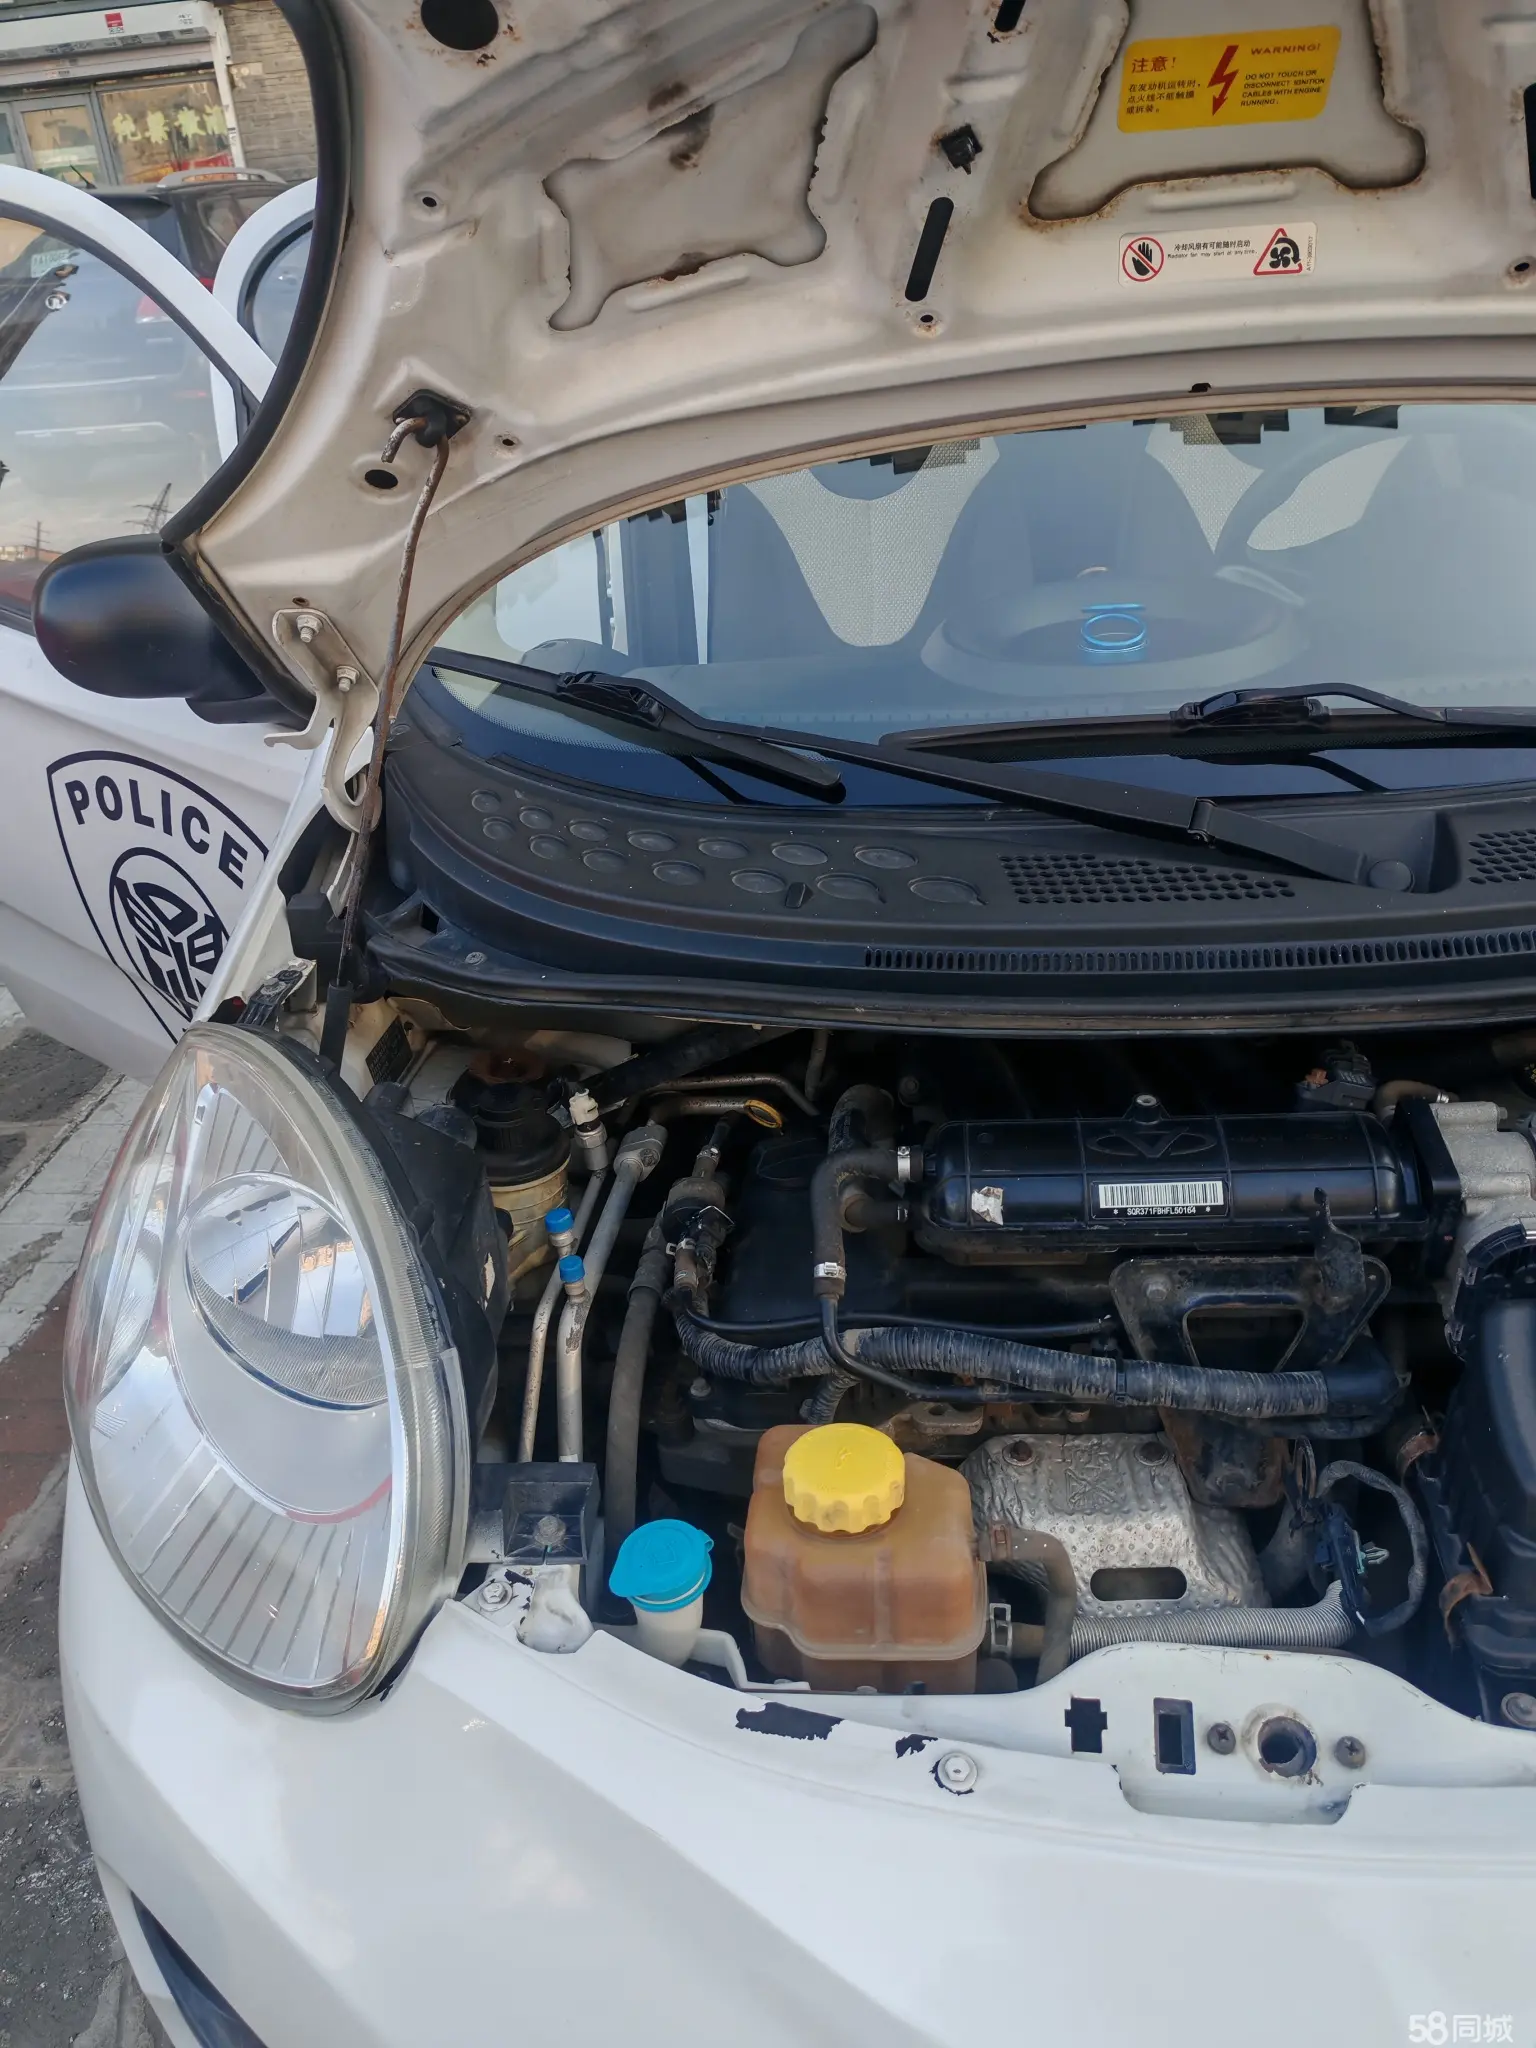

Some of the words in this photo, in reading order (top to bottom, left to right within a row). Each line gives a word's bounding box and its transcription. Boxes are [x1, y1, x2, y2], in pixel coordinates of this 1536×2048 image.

[1251, 43, 1321, 56] WARNING!
[1278, 70, 1304, 78] TOUCH
[1305, 69, 1317, 77] OR
[1243, 80, 1290, 89] DISCONNECT
[1293, 78, 1326, 86] IGNITION
[1242, 90, 1272, 98] CABLES
[1273, 88, 1293, 96] WITH
[1293, 86, 1322, 95] ENGINE
[1174, 239, 1251, 251] 冷却风扇有可能随时启动
[64, 774, 249, 890] POLICE
